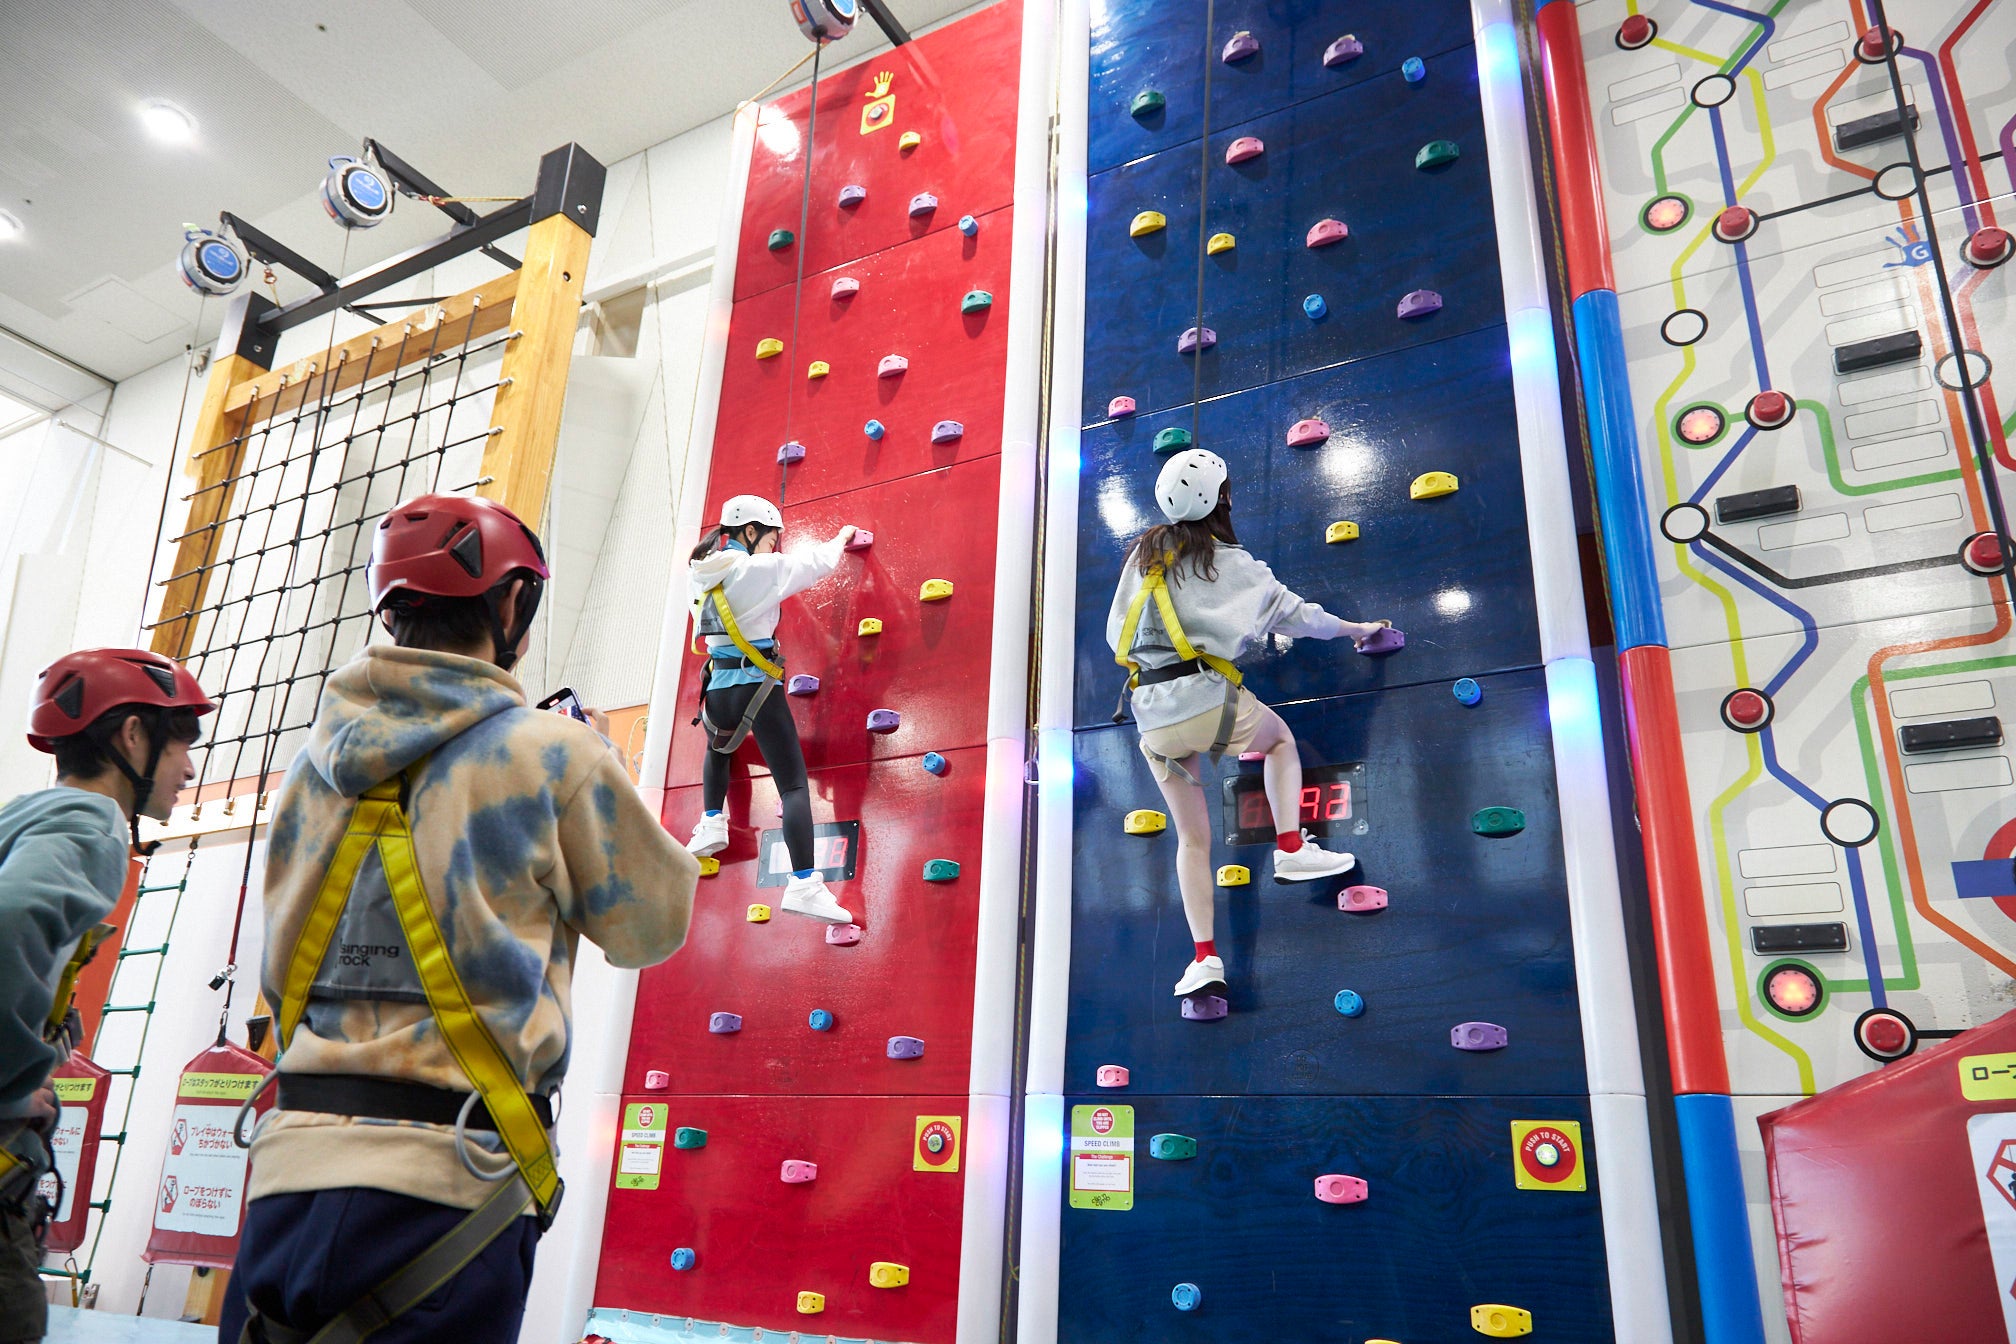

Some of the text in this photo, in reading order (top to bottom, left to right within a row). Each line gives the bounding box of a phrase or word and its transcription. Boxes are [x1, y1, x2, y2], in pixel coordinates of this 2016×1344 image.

[1911, 244, 1930, 260] G
[339, 943, 400, 959] singing
[338, 955, 371, 967] rock
[1972, 1064, 2016, 1081] ロー
[190, 1127, 248, 1139] プレイ中はウォーに
[922, 1127, 934, 1141] PUSH
[940, 1126, 953, 1141] START
[1102, 1140, 1121, 1148] CLIMB
[1525, 1131, 1571, 1153] PUSH TO START
[182, 1185, 233, 1199] ロープをつけずに
